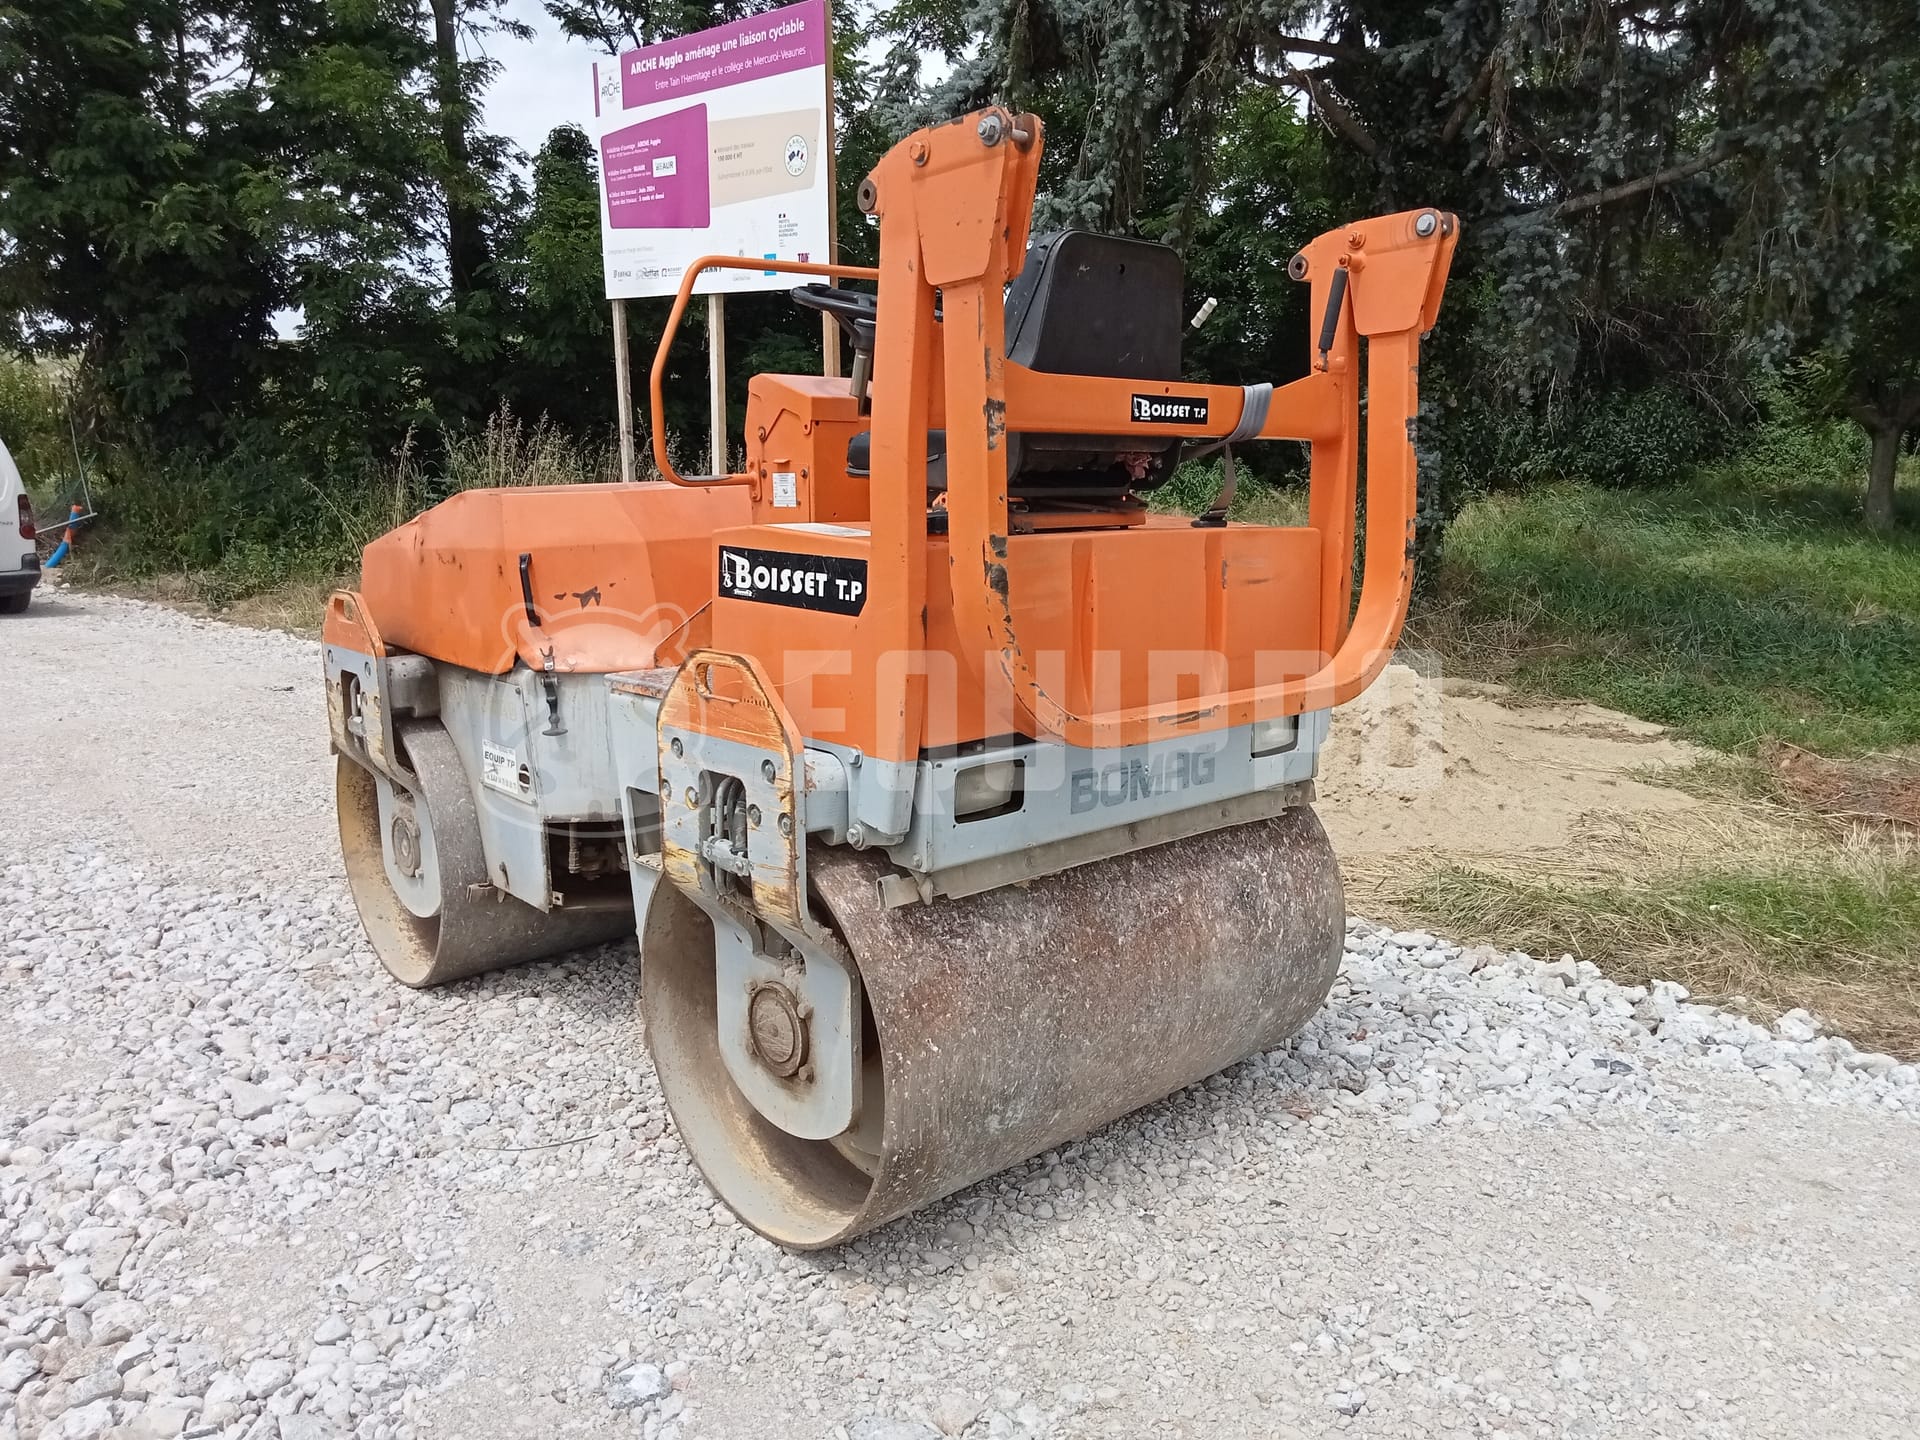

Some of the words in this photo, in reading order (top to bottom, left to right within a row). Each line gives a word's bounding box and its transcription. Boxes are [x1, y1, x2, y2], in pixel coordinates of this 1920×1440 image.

[631, 57, 657, 75] ARCHE
[659, 51, 683, 70] Agglo
[685, 43, 721, 62] aménage
[722, 38, 738, 51] une
[739, 30, 767, 47] liaison
[768, 17, 805, 42] cyclable
[655, 80, 669, 90] Entre
[669, 76, 680, 87] Tain
[681, 69, 711, 84] l'Hermitage
[711, 67, 718, 77] et
[718, 65, 723, 75] le
[724, 60, 744, 73] collège
[744, 58, 752, 69] de
[1193, 408, 1207, 418] T.P
[835, 578, 863, 602] T.P
[484, 751, 505, 765] EQUIP
[507, 759, 516, 769] TP
[1070, 742, 1216, 815] BOMAG
